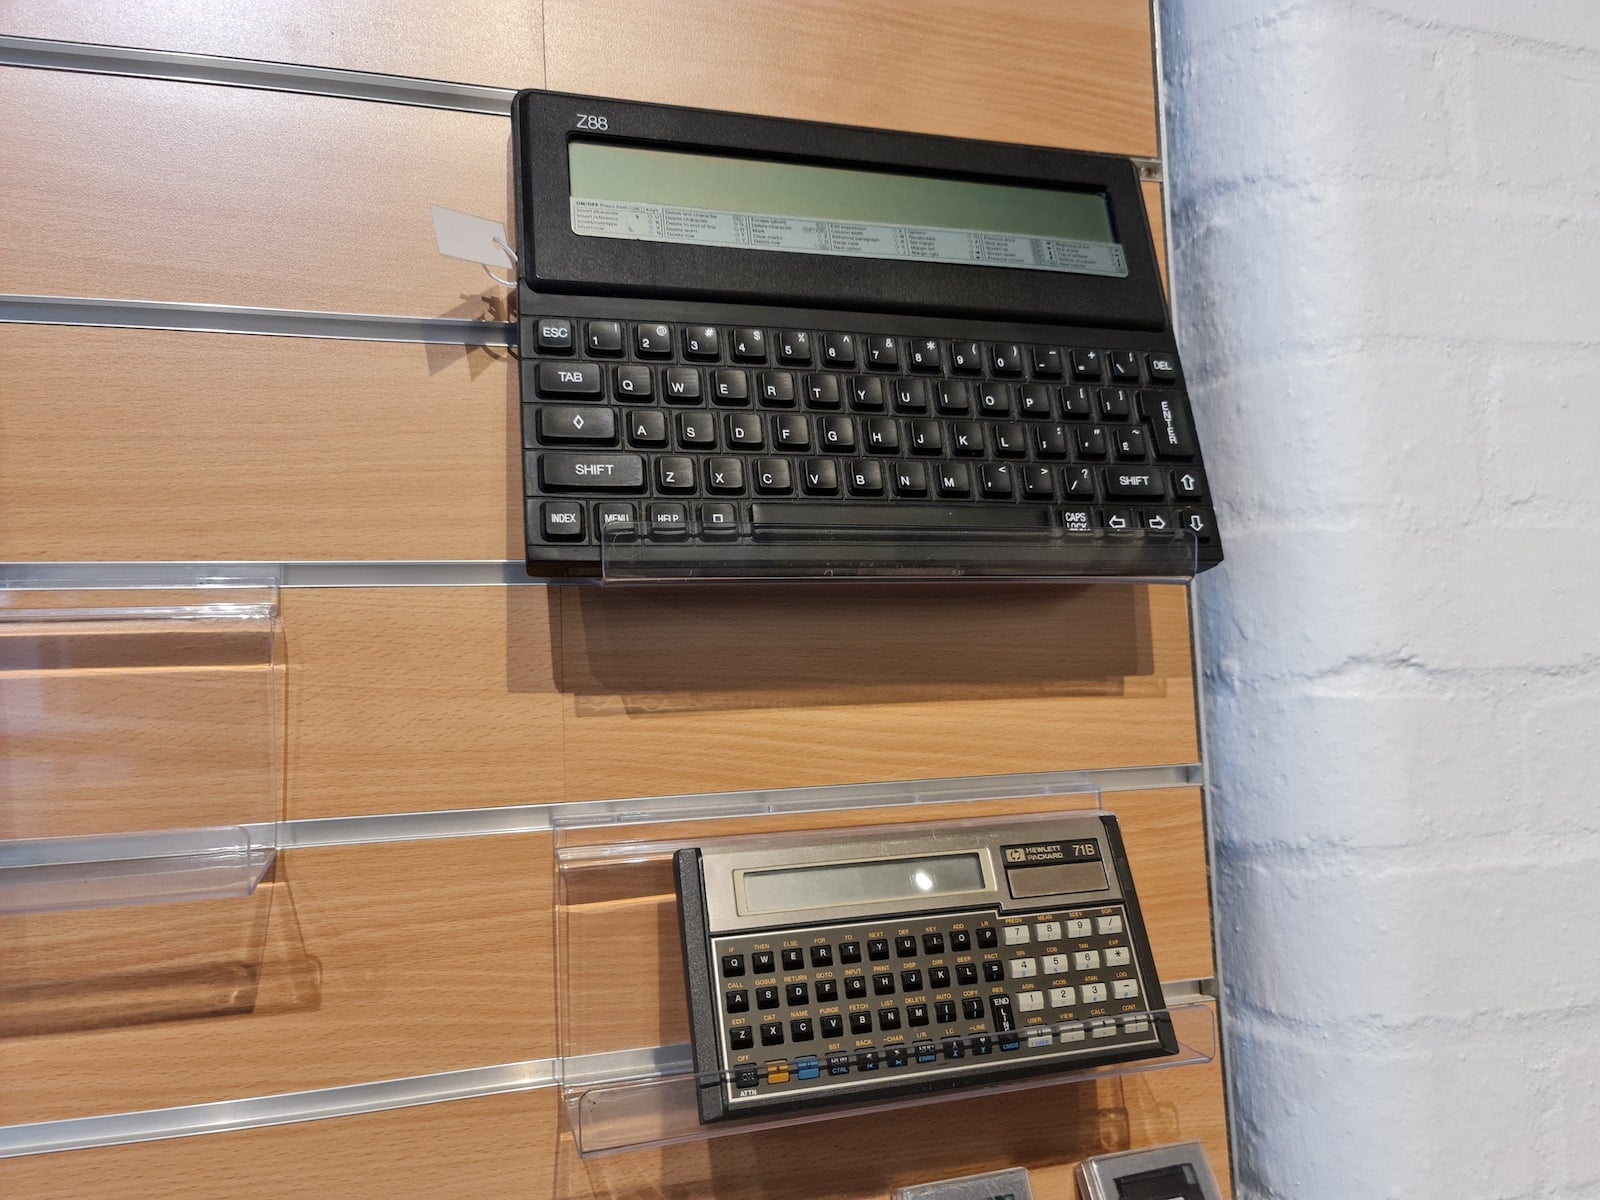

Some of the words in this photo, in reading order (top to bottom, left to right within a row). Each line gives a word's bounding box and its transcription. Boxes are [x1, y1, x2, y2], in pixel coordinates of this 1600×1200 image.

[576, 114, 608, 131] Z88
[542, 327, 568, 338] ESC
[592, 336, 598, 346] 1
[642, 338, 650, 348] 2
[690, 340, 698, 350] 3
[738, 343, 746, 352] 4
[785, 345, 792, 354] 5
[828, 348, 836, 358] 6
[872, 350, 880, 360] 7
[915, 352, 922, 362] 8
[956, 355, 964, 364] 9
[1152, 360, 1172, 371] DEL
[558, 371, 584, 382] TAB
[622, 380, 634, 392] Q
[672, 382, 684, 392] W
[720, 384, 728, 394] E
[768, 386, 776, 396] R
[812, 388, 822, 398] T
[858, 390, 866, 400] Y
[901, 392, 910, 402] U
[985, 396, 995, 406] O
[1026, 398, 1034, 408] P
[1160, 400, 1178, 444] ENTER
[637, 425, 647, 436] A
[686, 427, 696, 438] S
[735, 428, 744, 438] D
[782, 429, 790, 440] F
[828, 431, 838, 442] G
[872, 432, 882, 443] H
[917, 434, 924, 444] J
[958, 436, 968, 446] K
[1000, 437, 1009, 448] L
[575, 464, 614, 476] SHIFT
[666, 472, 675, 482] Z
[715, 472, 724, 484] X
[762, 474, 773, 484] C
[810, 474, 820, 484] V
[856, 475, 866, 485] B
[900, 476, 910, 486] N
[1119, 476, 1149, 486] SHIFT
[944, 478, 954, 488] M
[552, 513, 576, 523] INDEX
[1065, 512, 1086, 522] CAPS
[1026, 845, 1060, 854] HEWLETT
[1072, 844, 1095, 857] 71B
[1027, 852, 1064, 861] PACKARD
[844, 968, 862, 976] INPUT
[755, 978, 776, 986] GOSUB
[784, 974, 808, 982] RETURN
[904, 996, 926, 1004] DELETE
[994, 997, 1010, 1006] END
[740, 1089, 757, 1098] ATTN
